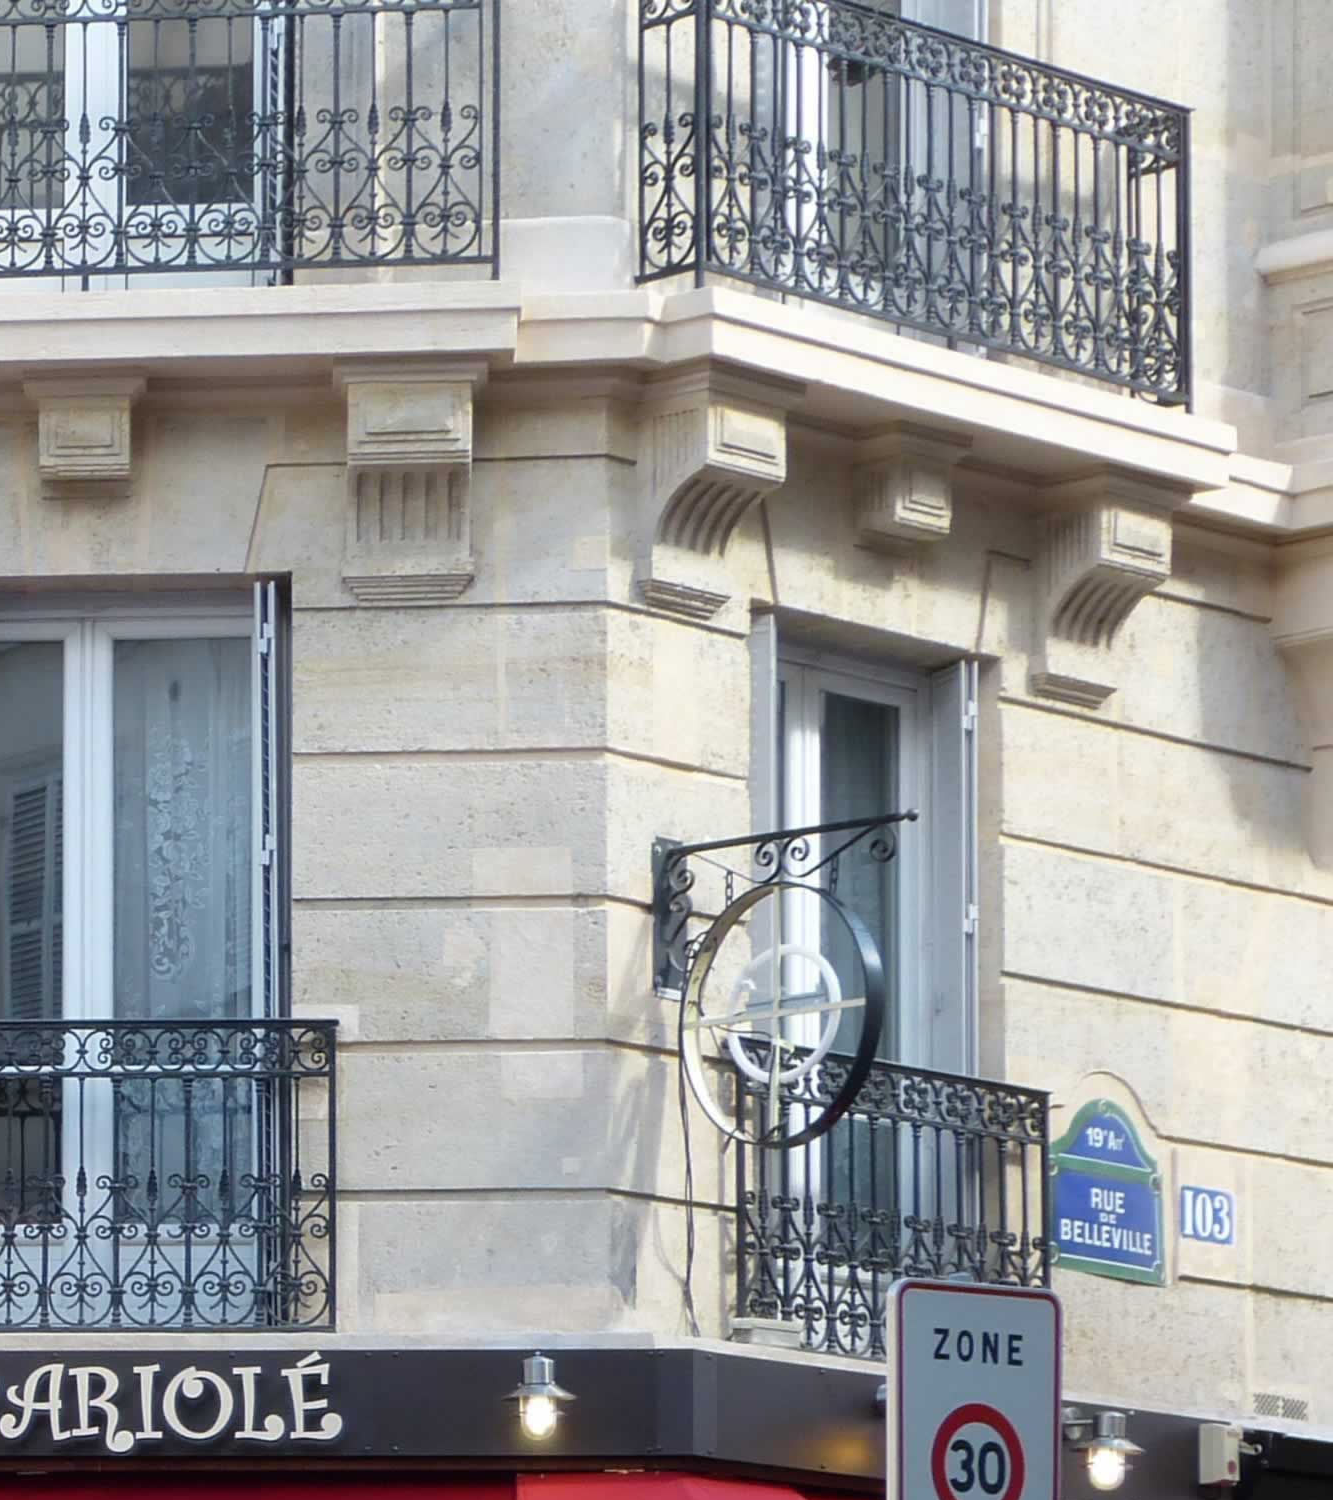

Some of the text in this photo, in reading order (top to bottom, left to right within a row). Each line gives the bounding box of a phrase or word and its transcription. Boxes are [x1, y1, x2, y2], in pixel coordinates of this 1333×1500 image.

[1091, 1187, 1125, 1213] RUE
[1099, 1212, 1117, 1224] DE
[1183, 1190, 1230, 1240] 103
[1060, 1218, 1153, 1254] BELLEVILLE
[933, 1328, 1024, 1366] ZONE
[950, 1439, 1006, 1495] 30
